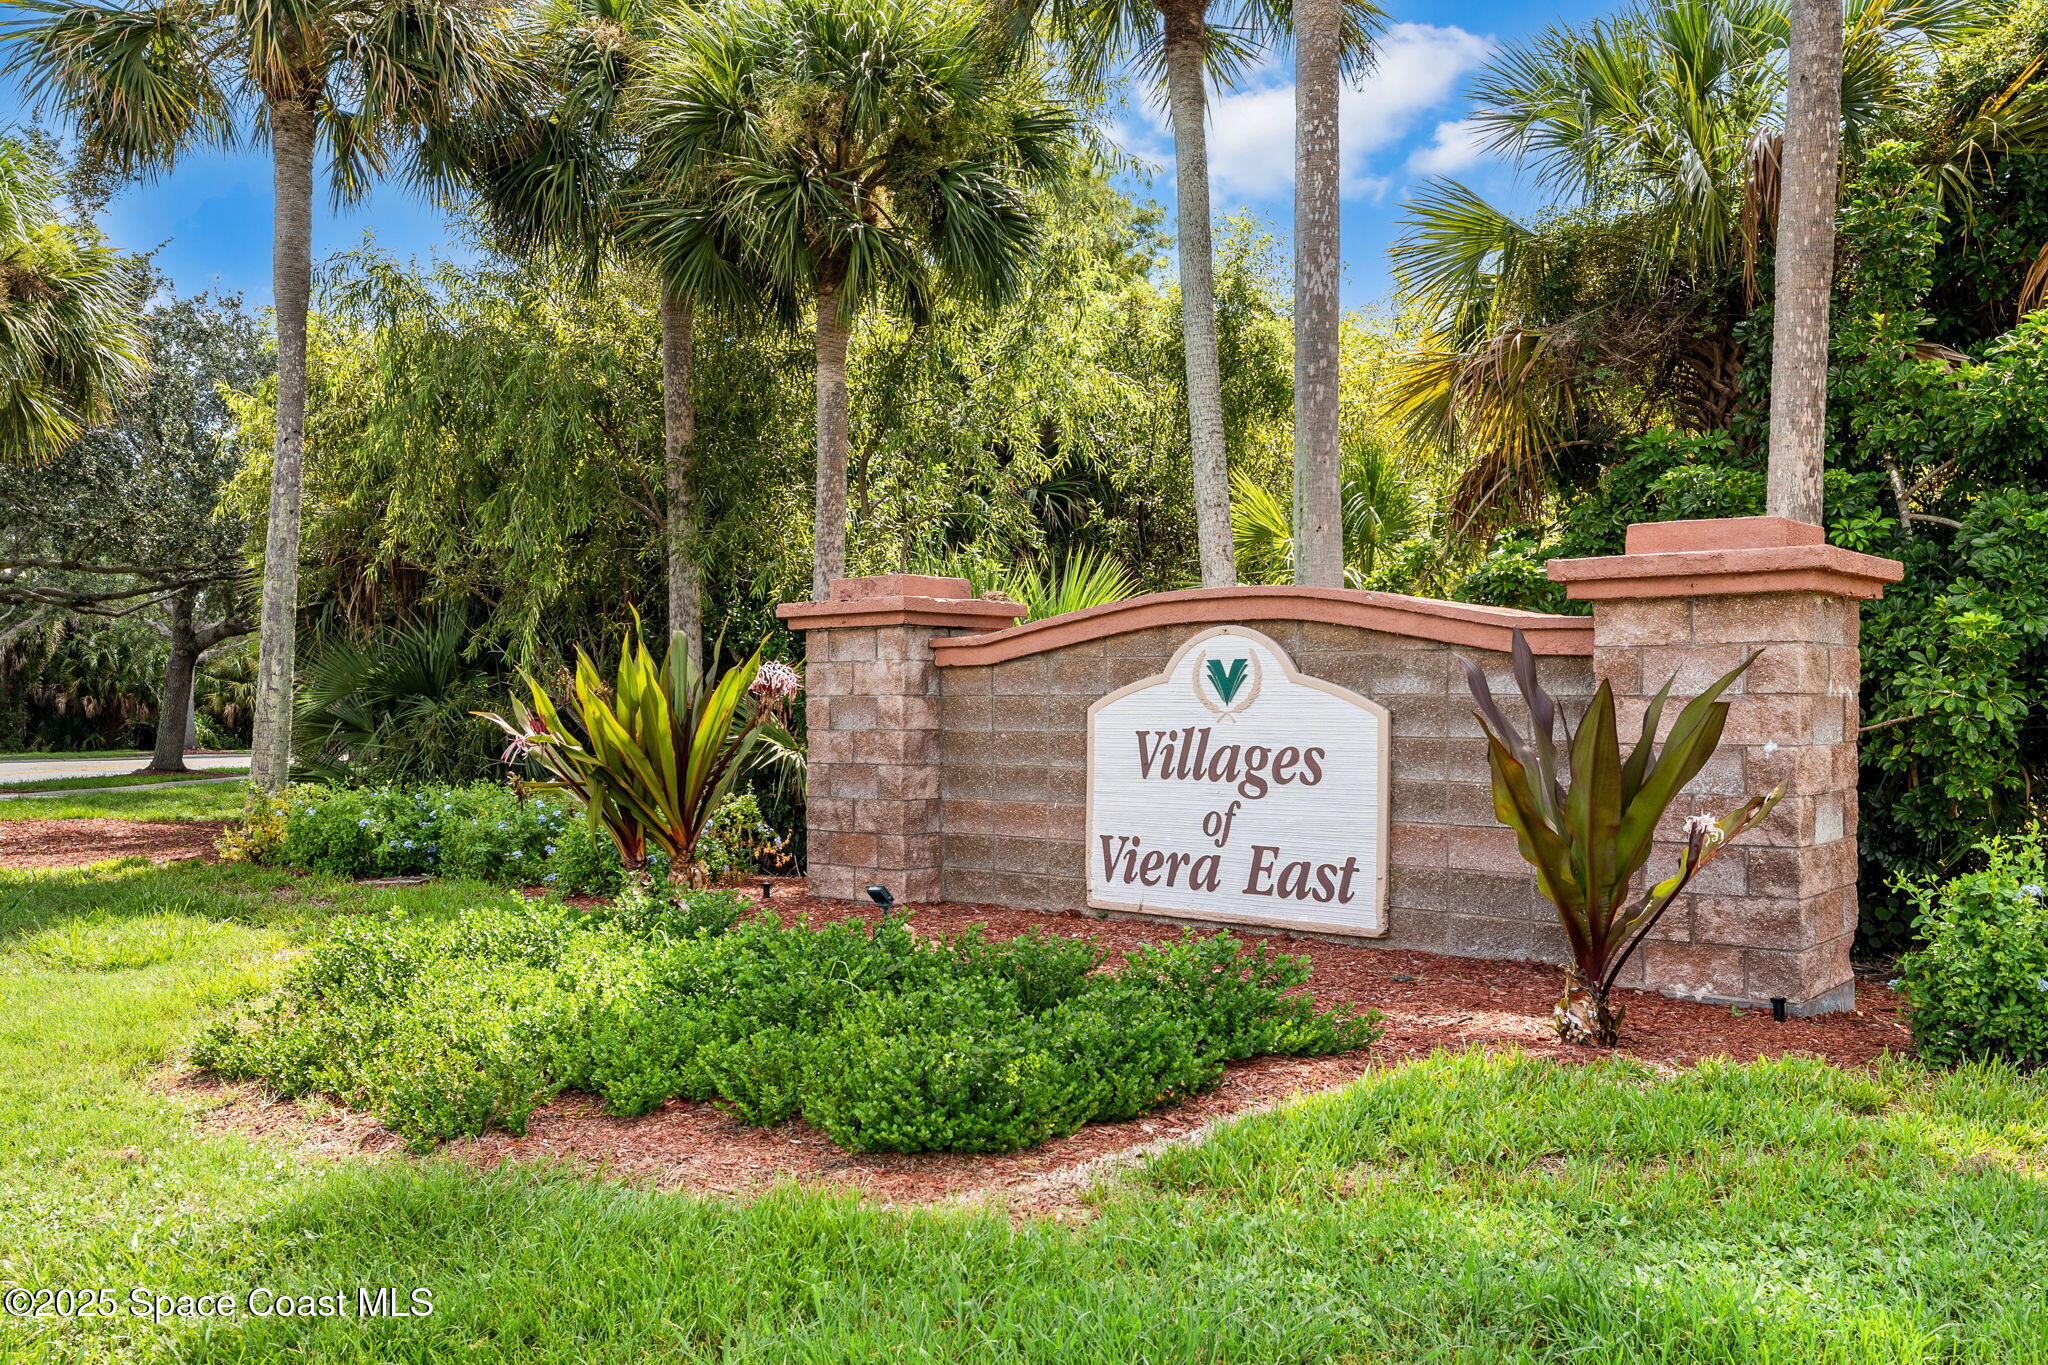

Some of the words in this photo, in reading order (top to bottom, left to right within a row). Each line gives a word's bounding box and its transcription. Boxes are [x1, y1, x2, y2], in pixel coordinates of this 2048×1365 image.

[1135, 726, 1326, 800] Villages
[1202, 800, 1241, 848] of
[1099, 834, 1221, 892] Viera
[1242, 844, 1360, 904] East
